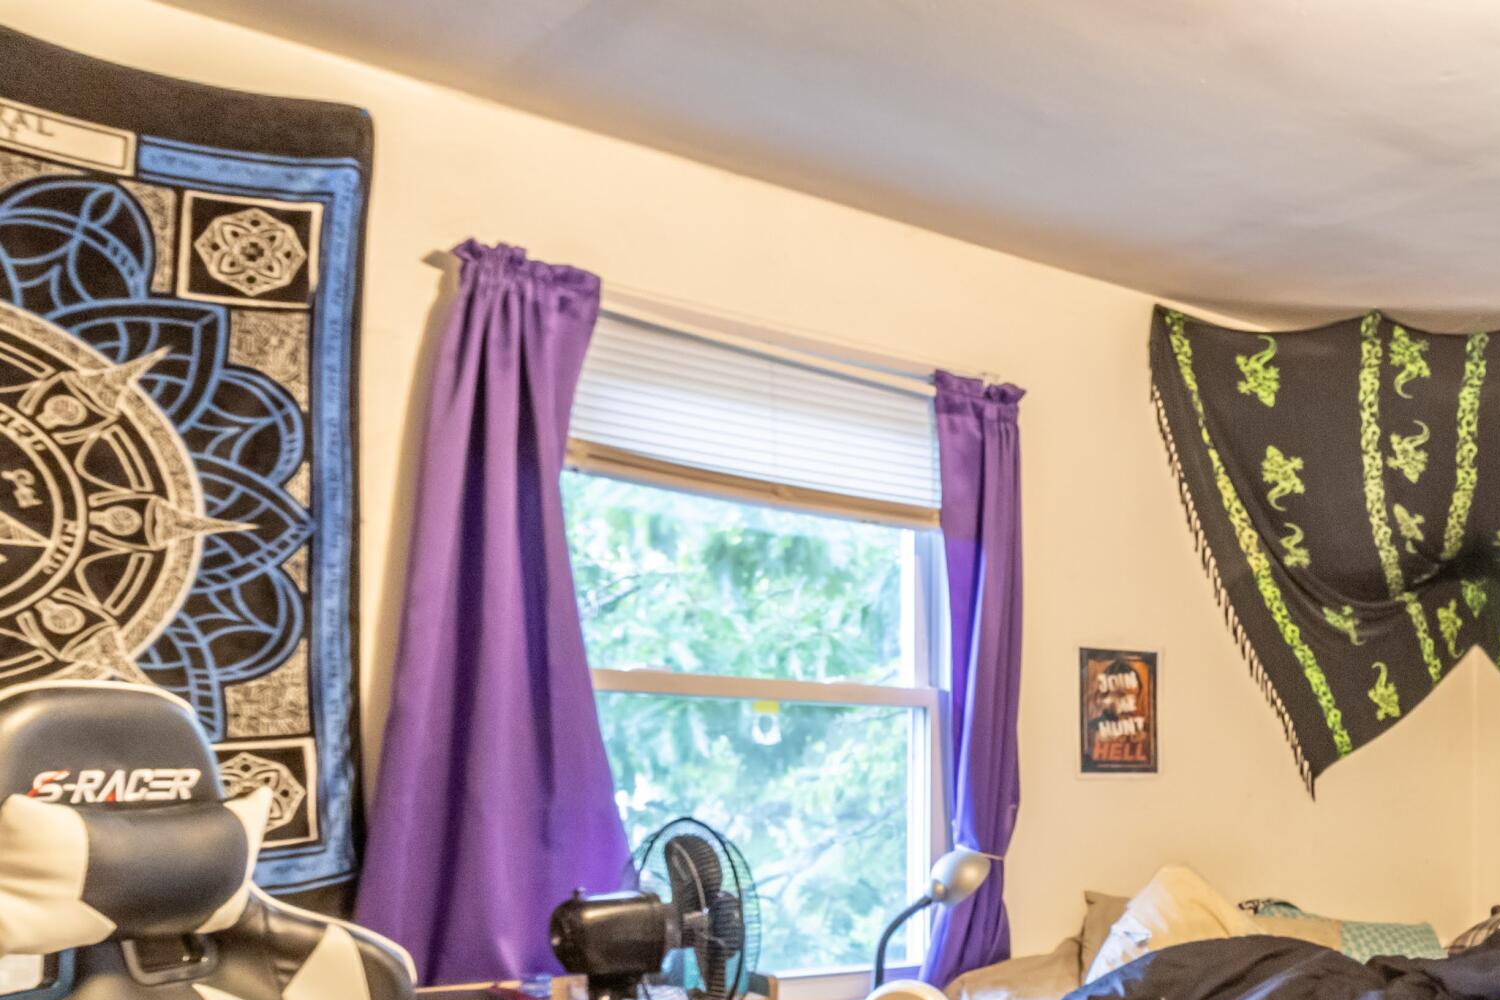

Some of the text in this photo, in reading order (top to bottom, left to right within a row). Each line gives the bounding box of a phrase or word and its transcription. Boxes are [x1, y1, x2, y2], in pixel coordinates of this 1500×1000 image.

[1097, 671, 1138, 693] JOIN
[1098, 717, 1145, 740] HUNT
[1092, 740, 1148, 761] HELL
[27, 768, 201, 804] S-RACER
